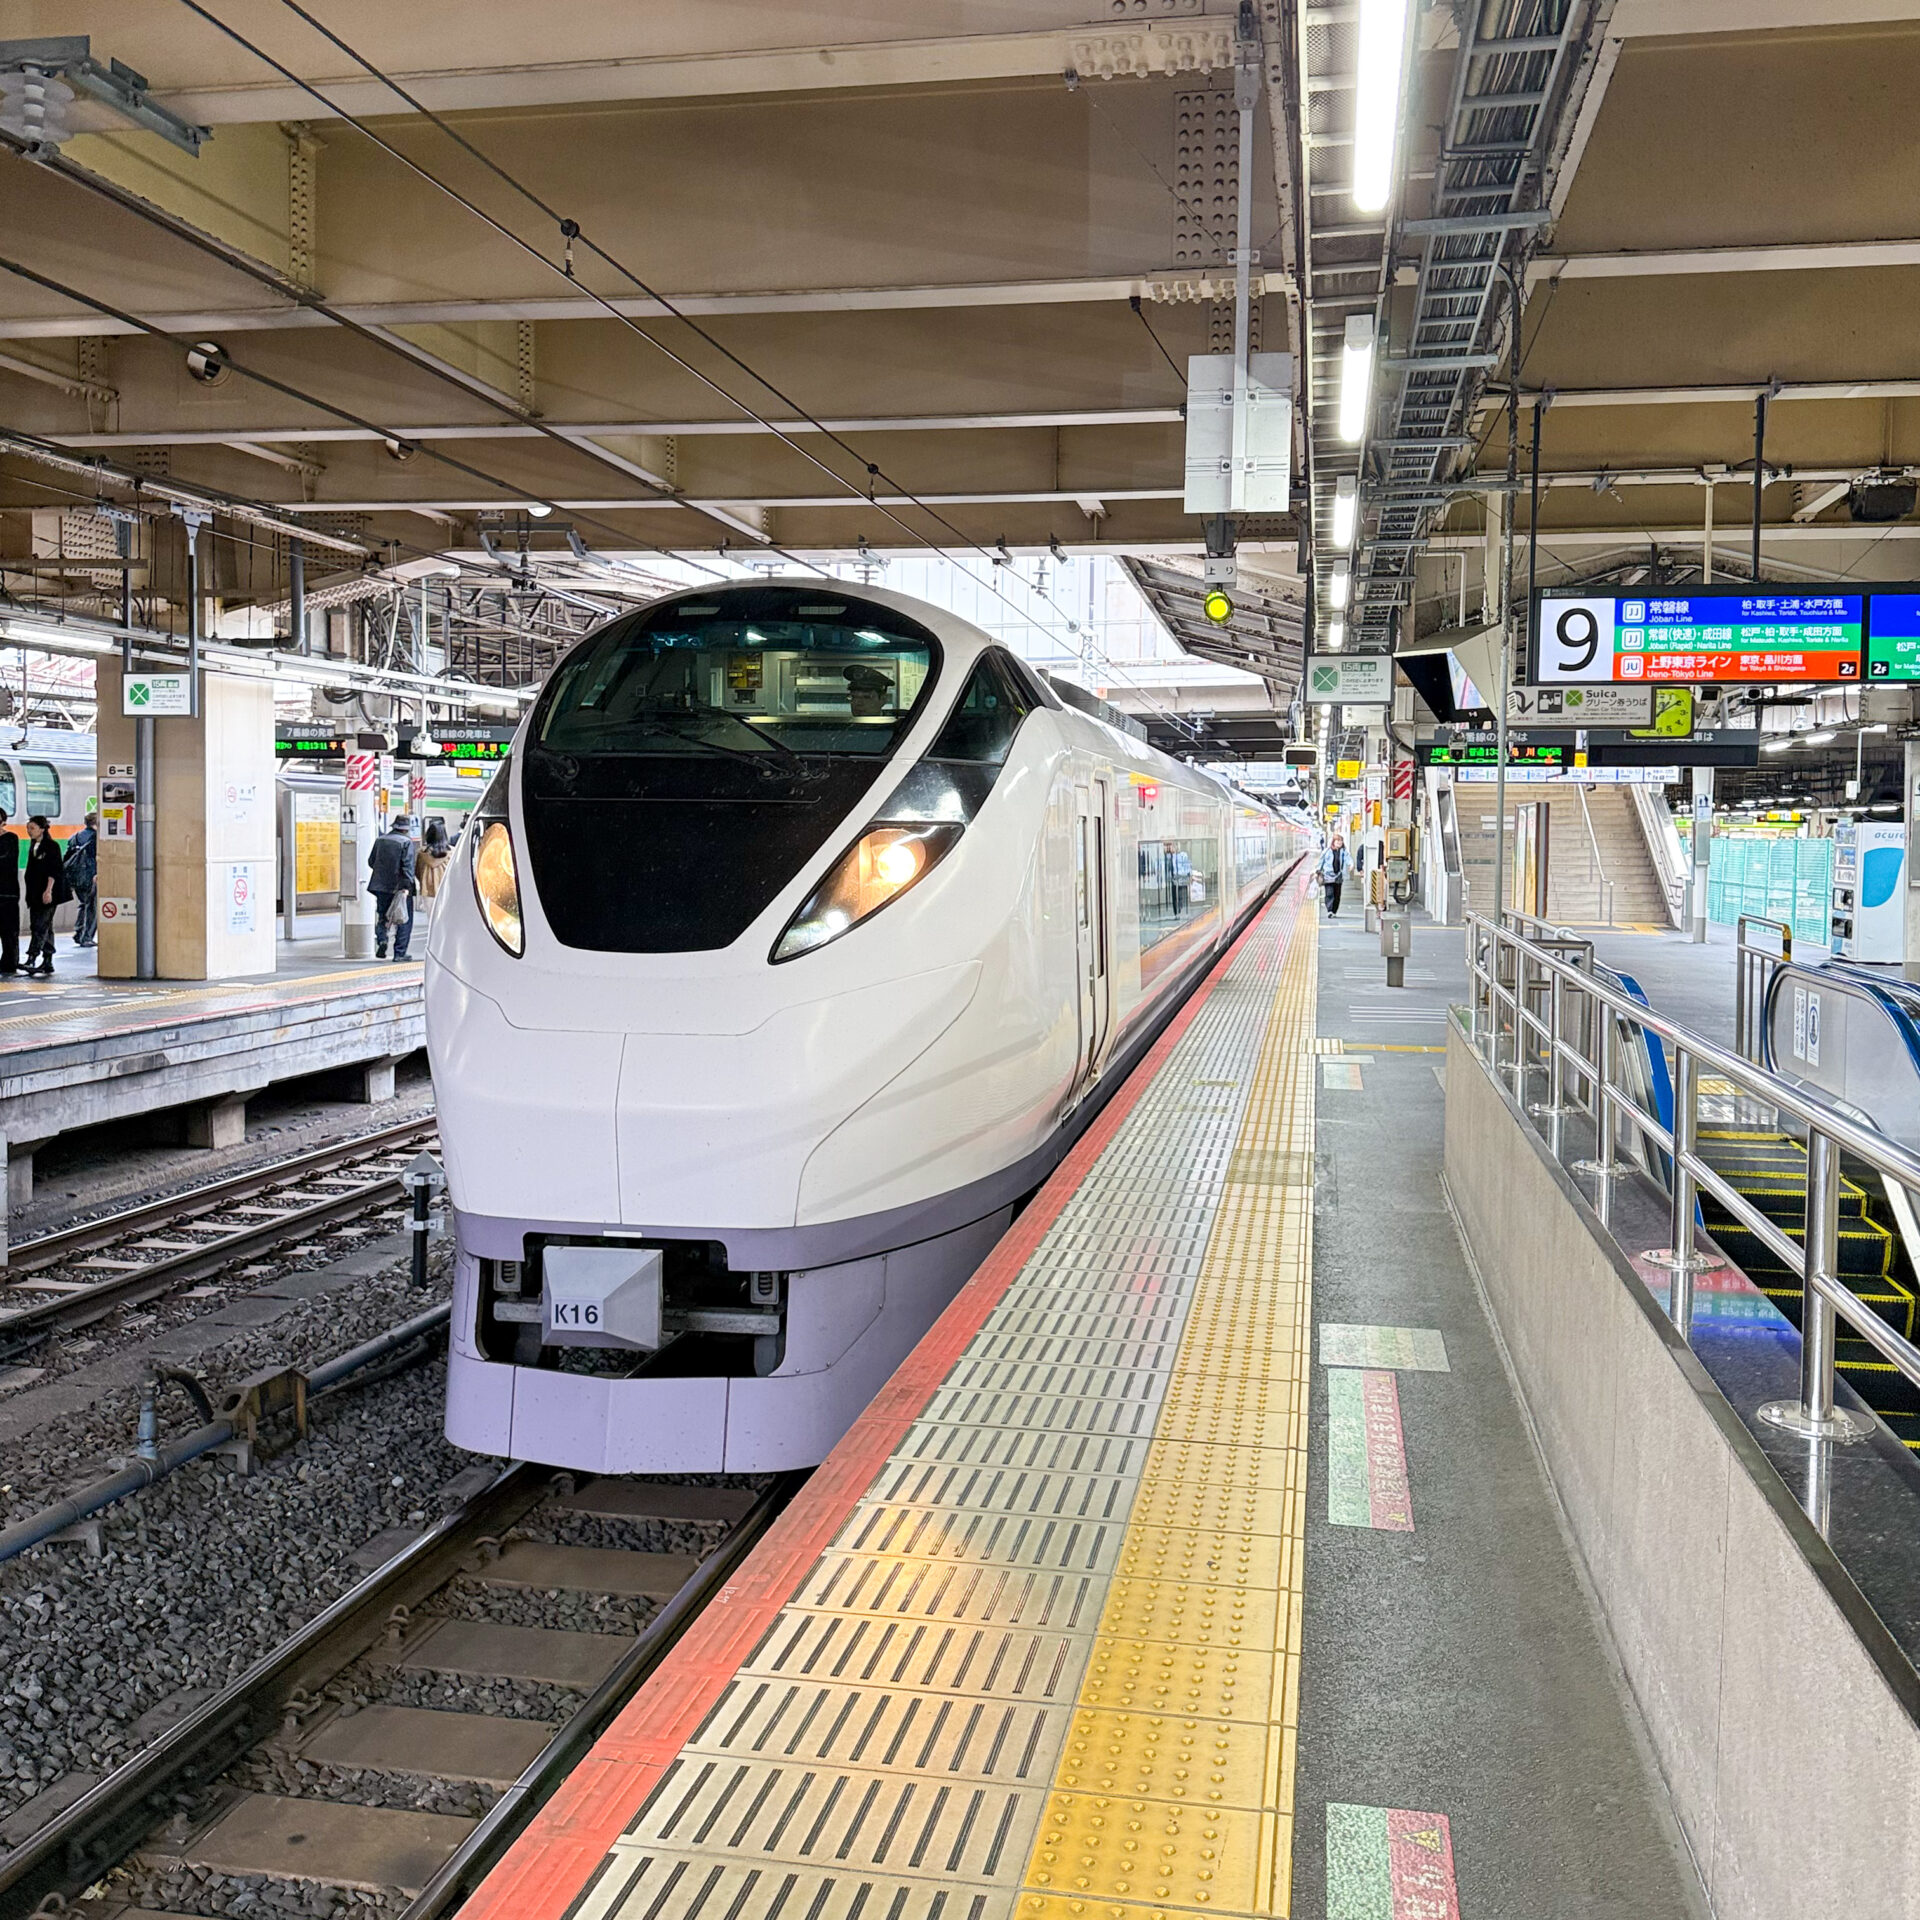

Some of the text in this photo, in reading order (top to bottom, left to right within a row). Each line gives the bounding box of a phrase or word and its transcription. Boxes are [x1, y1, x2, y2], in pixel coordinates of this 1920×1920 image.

[1628, 607, 1639, 617] JJ
[1648, 600, 1690, 614] 常磐線
[1675, 615, 1694, 623] Line
[1556, 607, 1599, 672] 9
[1628, 634, 1639, 644] JJ
[1717, 641, 1733, 650] Line
[1647, 655, 1733, 669] 上野東京ライン
[1740, 654, 1803, 665] 東京・品川方面
[1626, 662, 1639, 671] JU
[1840, 663, 1856, 675] 2F
[1873, 663, 1888, 675] 2F
[1696, 670, 1715, 678] Line
[1586, 689, 1618, 698] Suica
[1585, 698, 1648, 707] グリーン券うりば
[432, 729, 491, 739] 8番線の発車は
[554, 1303, 600, 1325] K16
